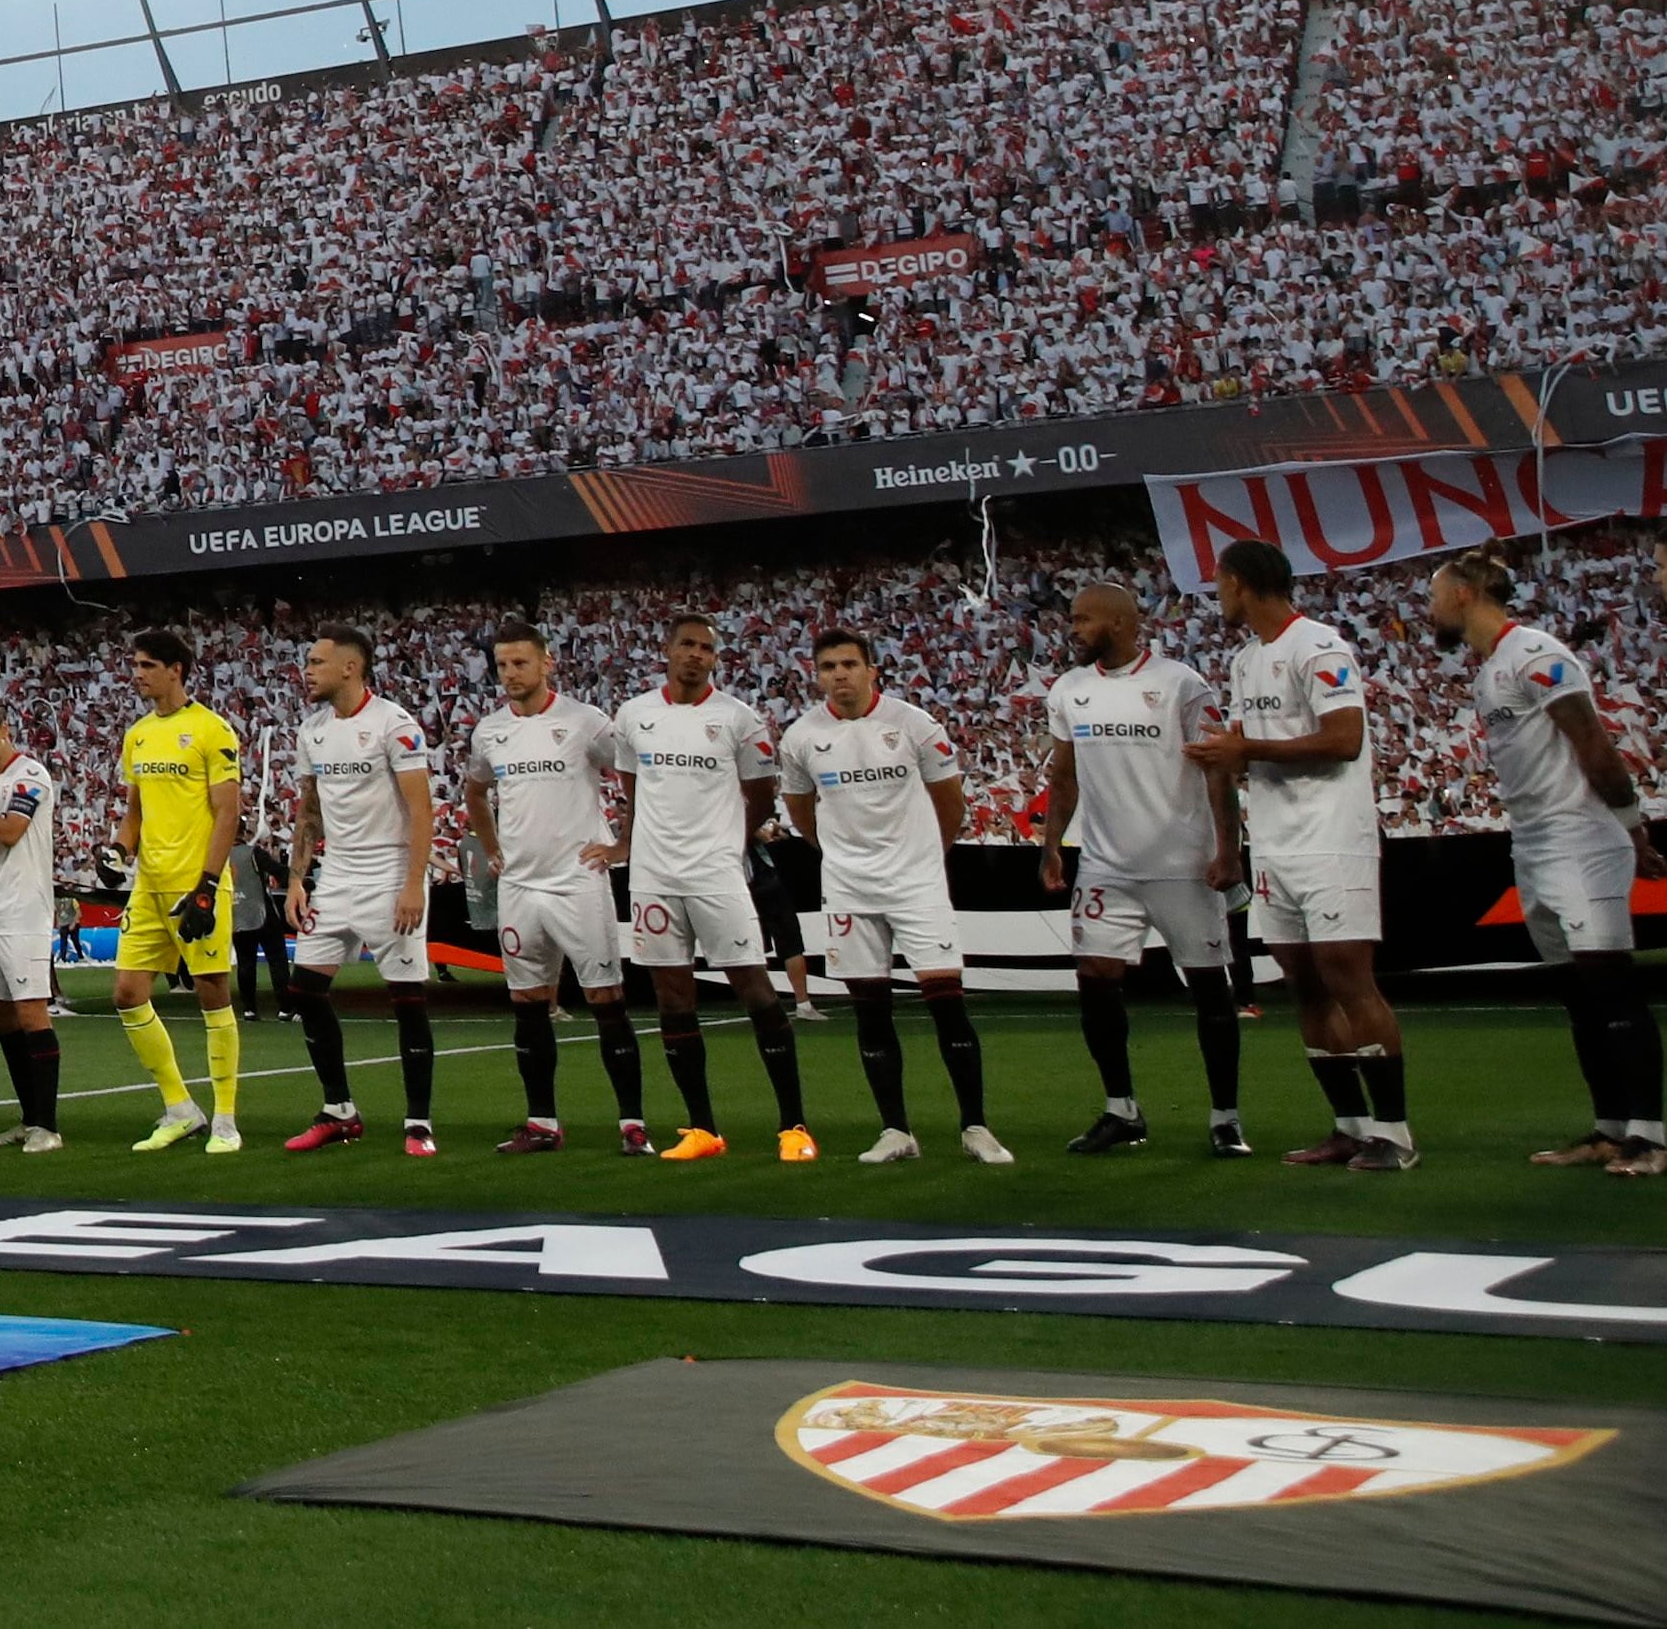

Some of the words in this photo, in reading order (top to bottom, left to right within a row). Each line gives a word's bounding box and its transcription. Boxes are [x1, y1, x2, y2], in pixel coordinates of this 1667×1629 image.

[873, 460, 1001, 490] Heineken
[1175, 440, 1667, 584] NUNC
[189, 528, 258, 554] UEFA
[264, 518, 367, 547] EUROPA
[374, 506, 481, 538] LEAGUE
[1092, 724, 1161, 738] DEGIRO
[142, 762, 189, 776] DEGIRO
[324, 762, 372, 776] DEGIRO
[507, 760, 566, 776] DEGIRO
[653, 752, 717, 770] DEGIRO
[840, 764, 908, 785] DEGIRO
[1072, 887, 1105, 920] 23
[633, 902, 669, 935] 20
[827, 913, 852, 937] 19
